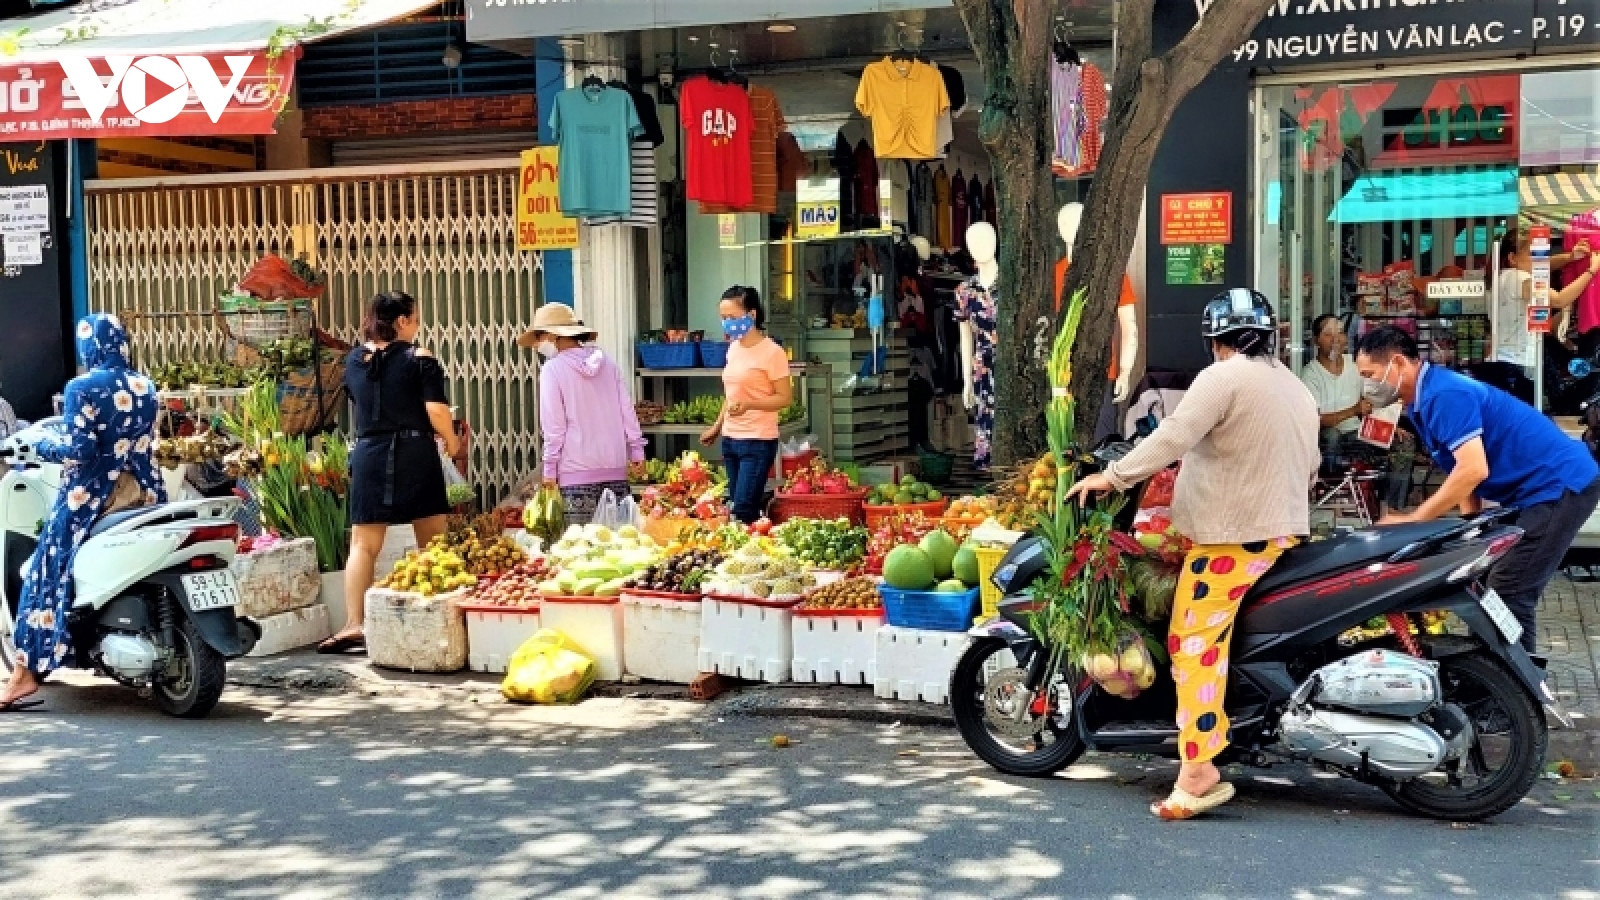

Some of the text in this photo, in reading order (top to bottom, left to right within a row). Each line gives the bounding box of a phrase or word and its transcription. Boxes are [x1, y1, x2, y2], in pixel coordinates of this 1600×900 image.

[1386, 24, 1443, 50] VĂN
[1451, 21, 1505, 47] LẠC
[702, 108, 737, 139] GAP
[522, 153, 558, 194] ph
[519, 221, 537, 244] 56
